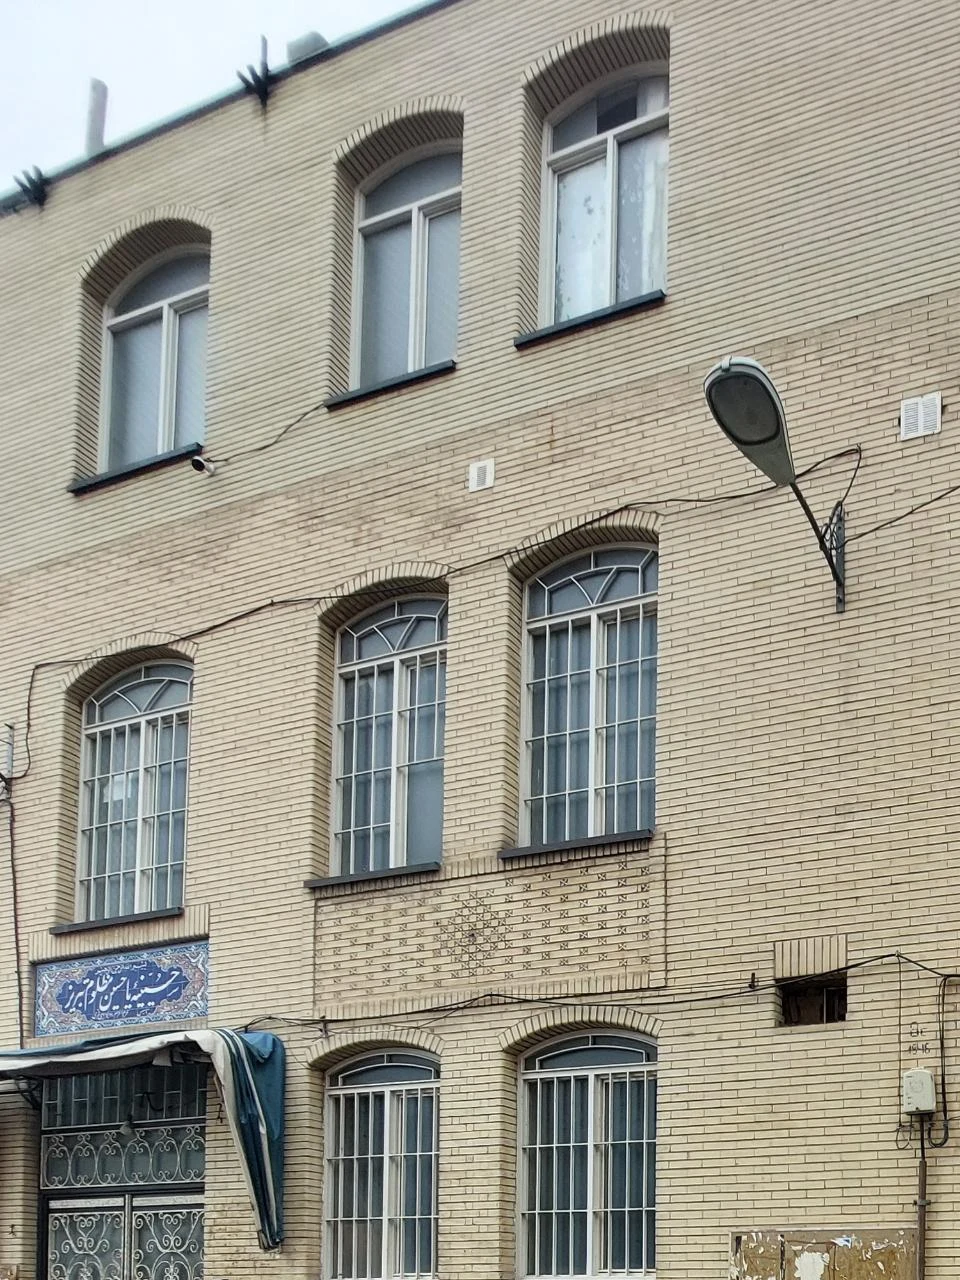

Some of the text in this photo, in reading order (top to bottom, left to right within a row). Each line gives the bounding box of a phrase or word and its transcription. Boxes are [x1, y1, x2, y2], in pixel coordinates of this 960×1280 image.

[64, 978, 89, 1013] تبریز
[83, 974, 114, 1011] مظلوم
[99, 976, 127, 1011] حسین
